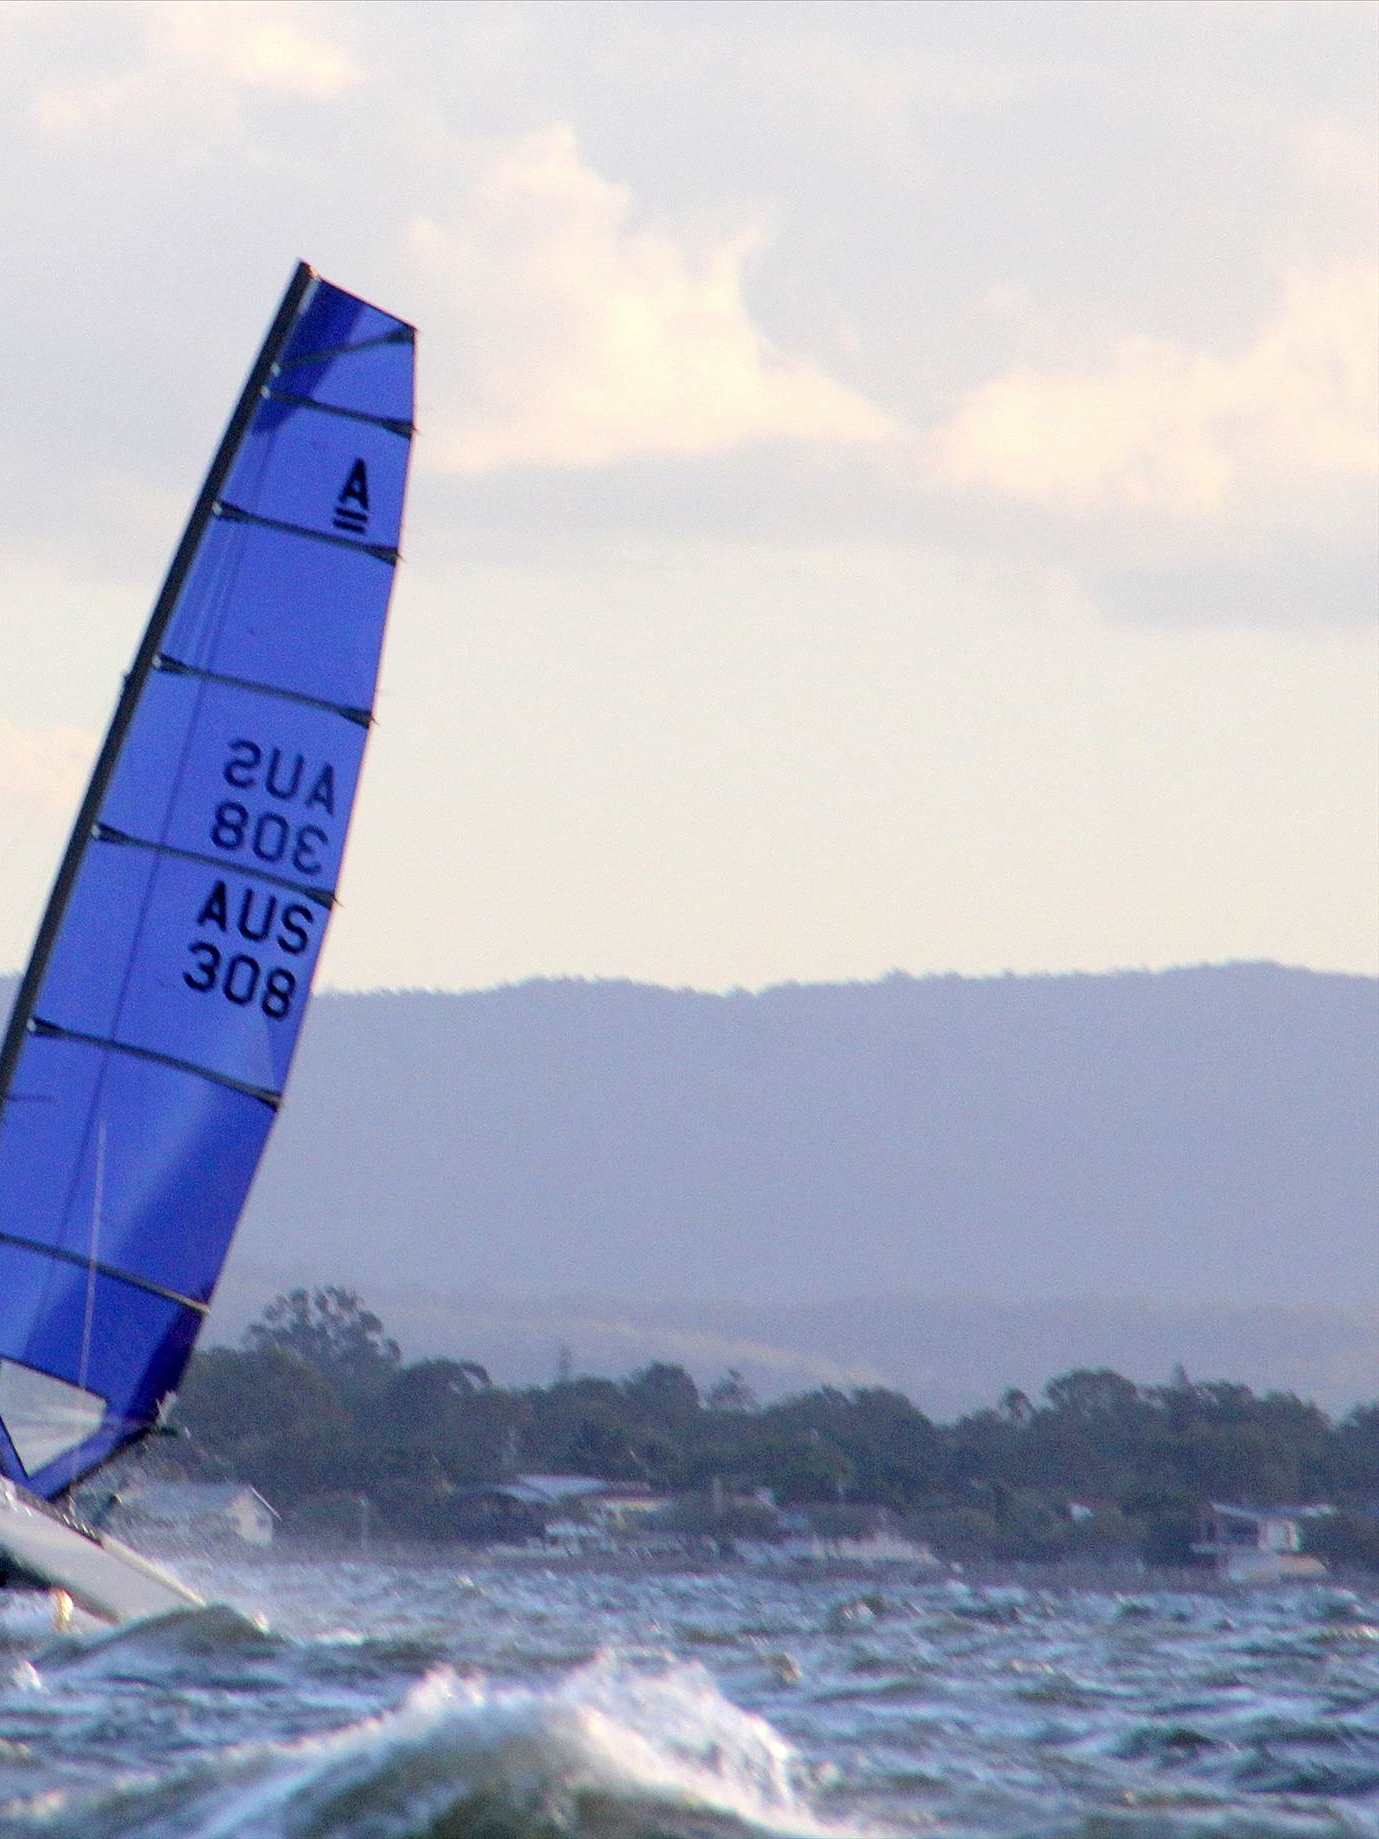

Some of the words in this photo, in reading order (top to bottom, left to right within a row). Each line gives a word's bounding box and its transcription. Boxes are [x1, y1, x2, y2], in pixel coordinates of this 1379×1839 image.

[339, 457, 369, 510] A
[197, 880, 314, 955] AUS
[182, 941, 297, 1019] 308
